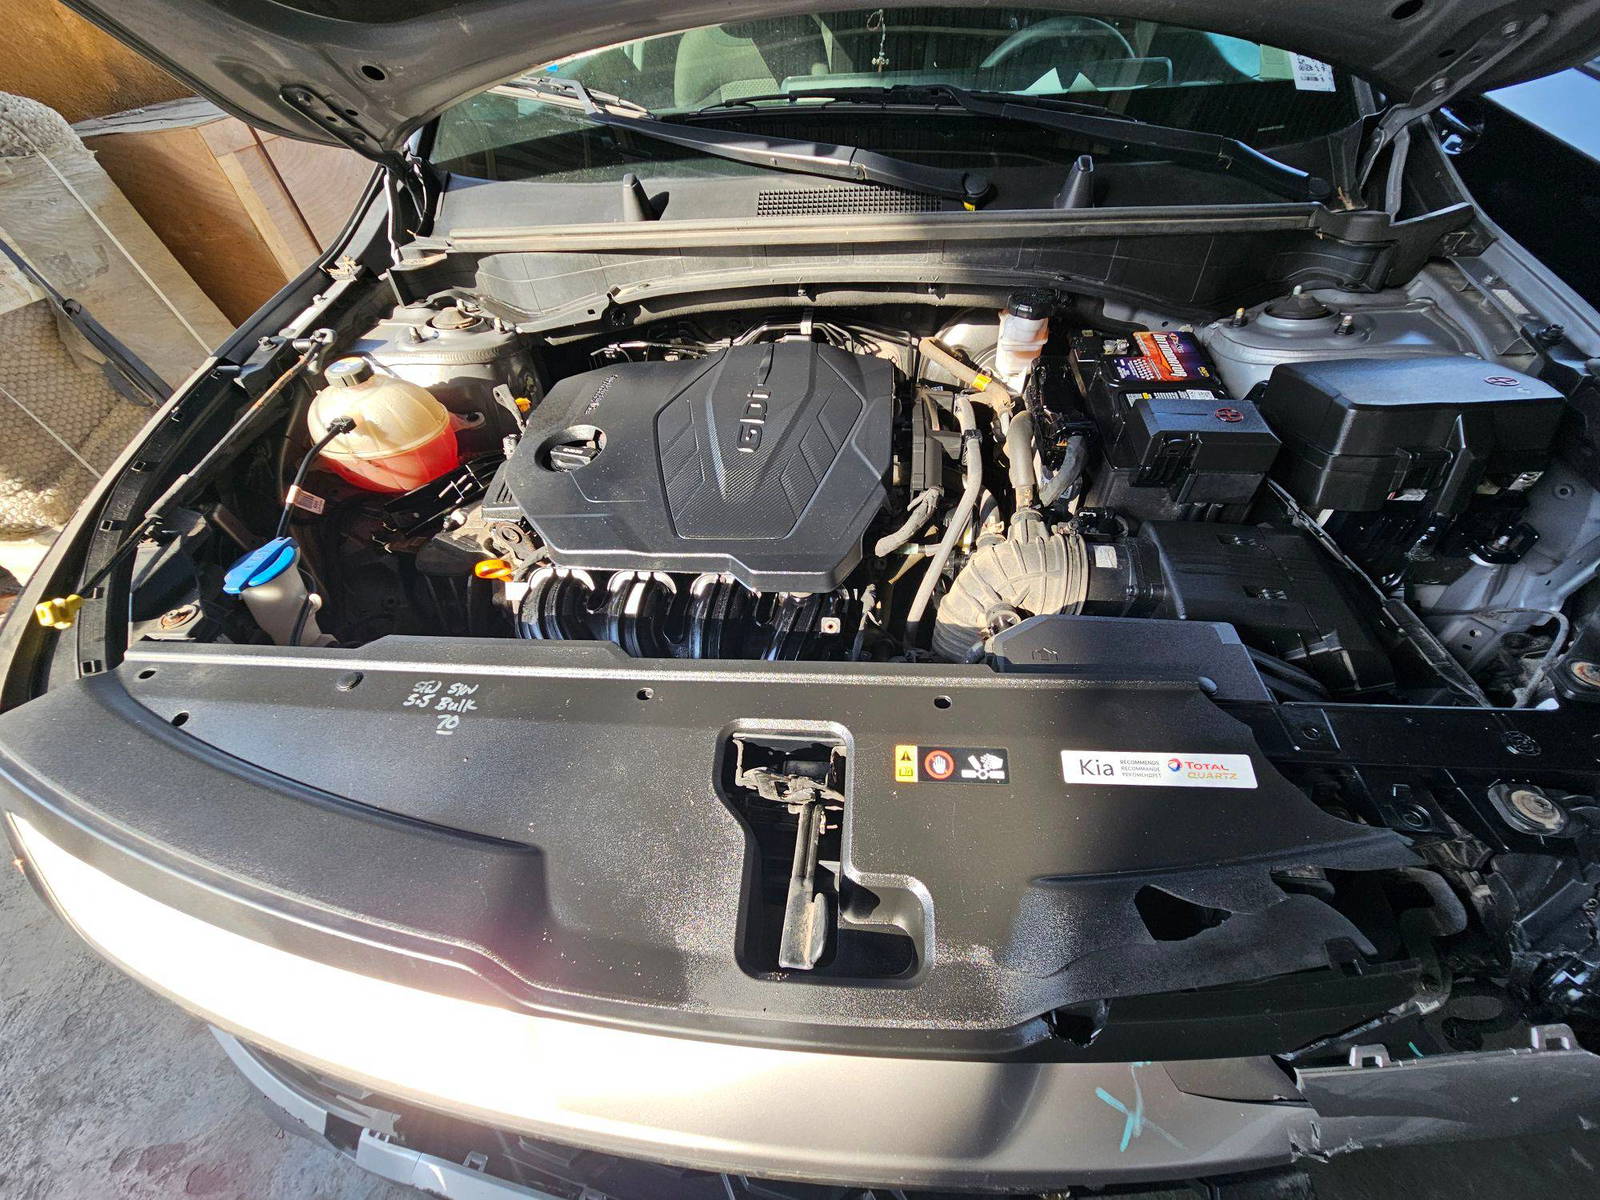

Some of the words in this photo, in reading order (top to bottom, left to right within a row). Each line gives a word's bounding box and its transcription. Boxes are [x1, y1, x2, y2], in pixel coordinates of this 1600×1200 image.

[436, 714, 460, 730] 70
[1079, 759, 1115, 777] Kia
[1187, 771, 1238, 780] QUARTZ
